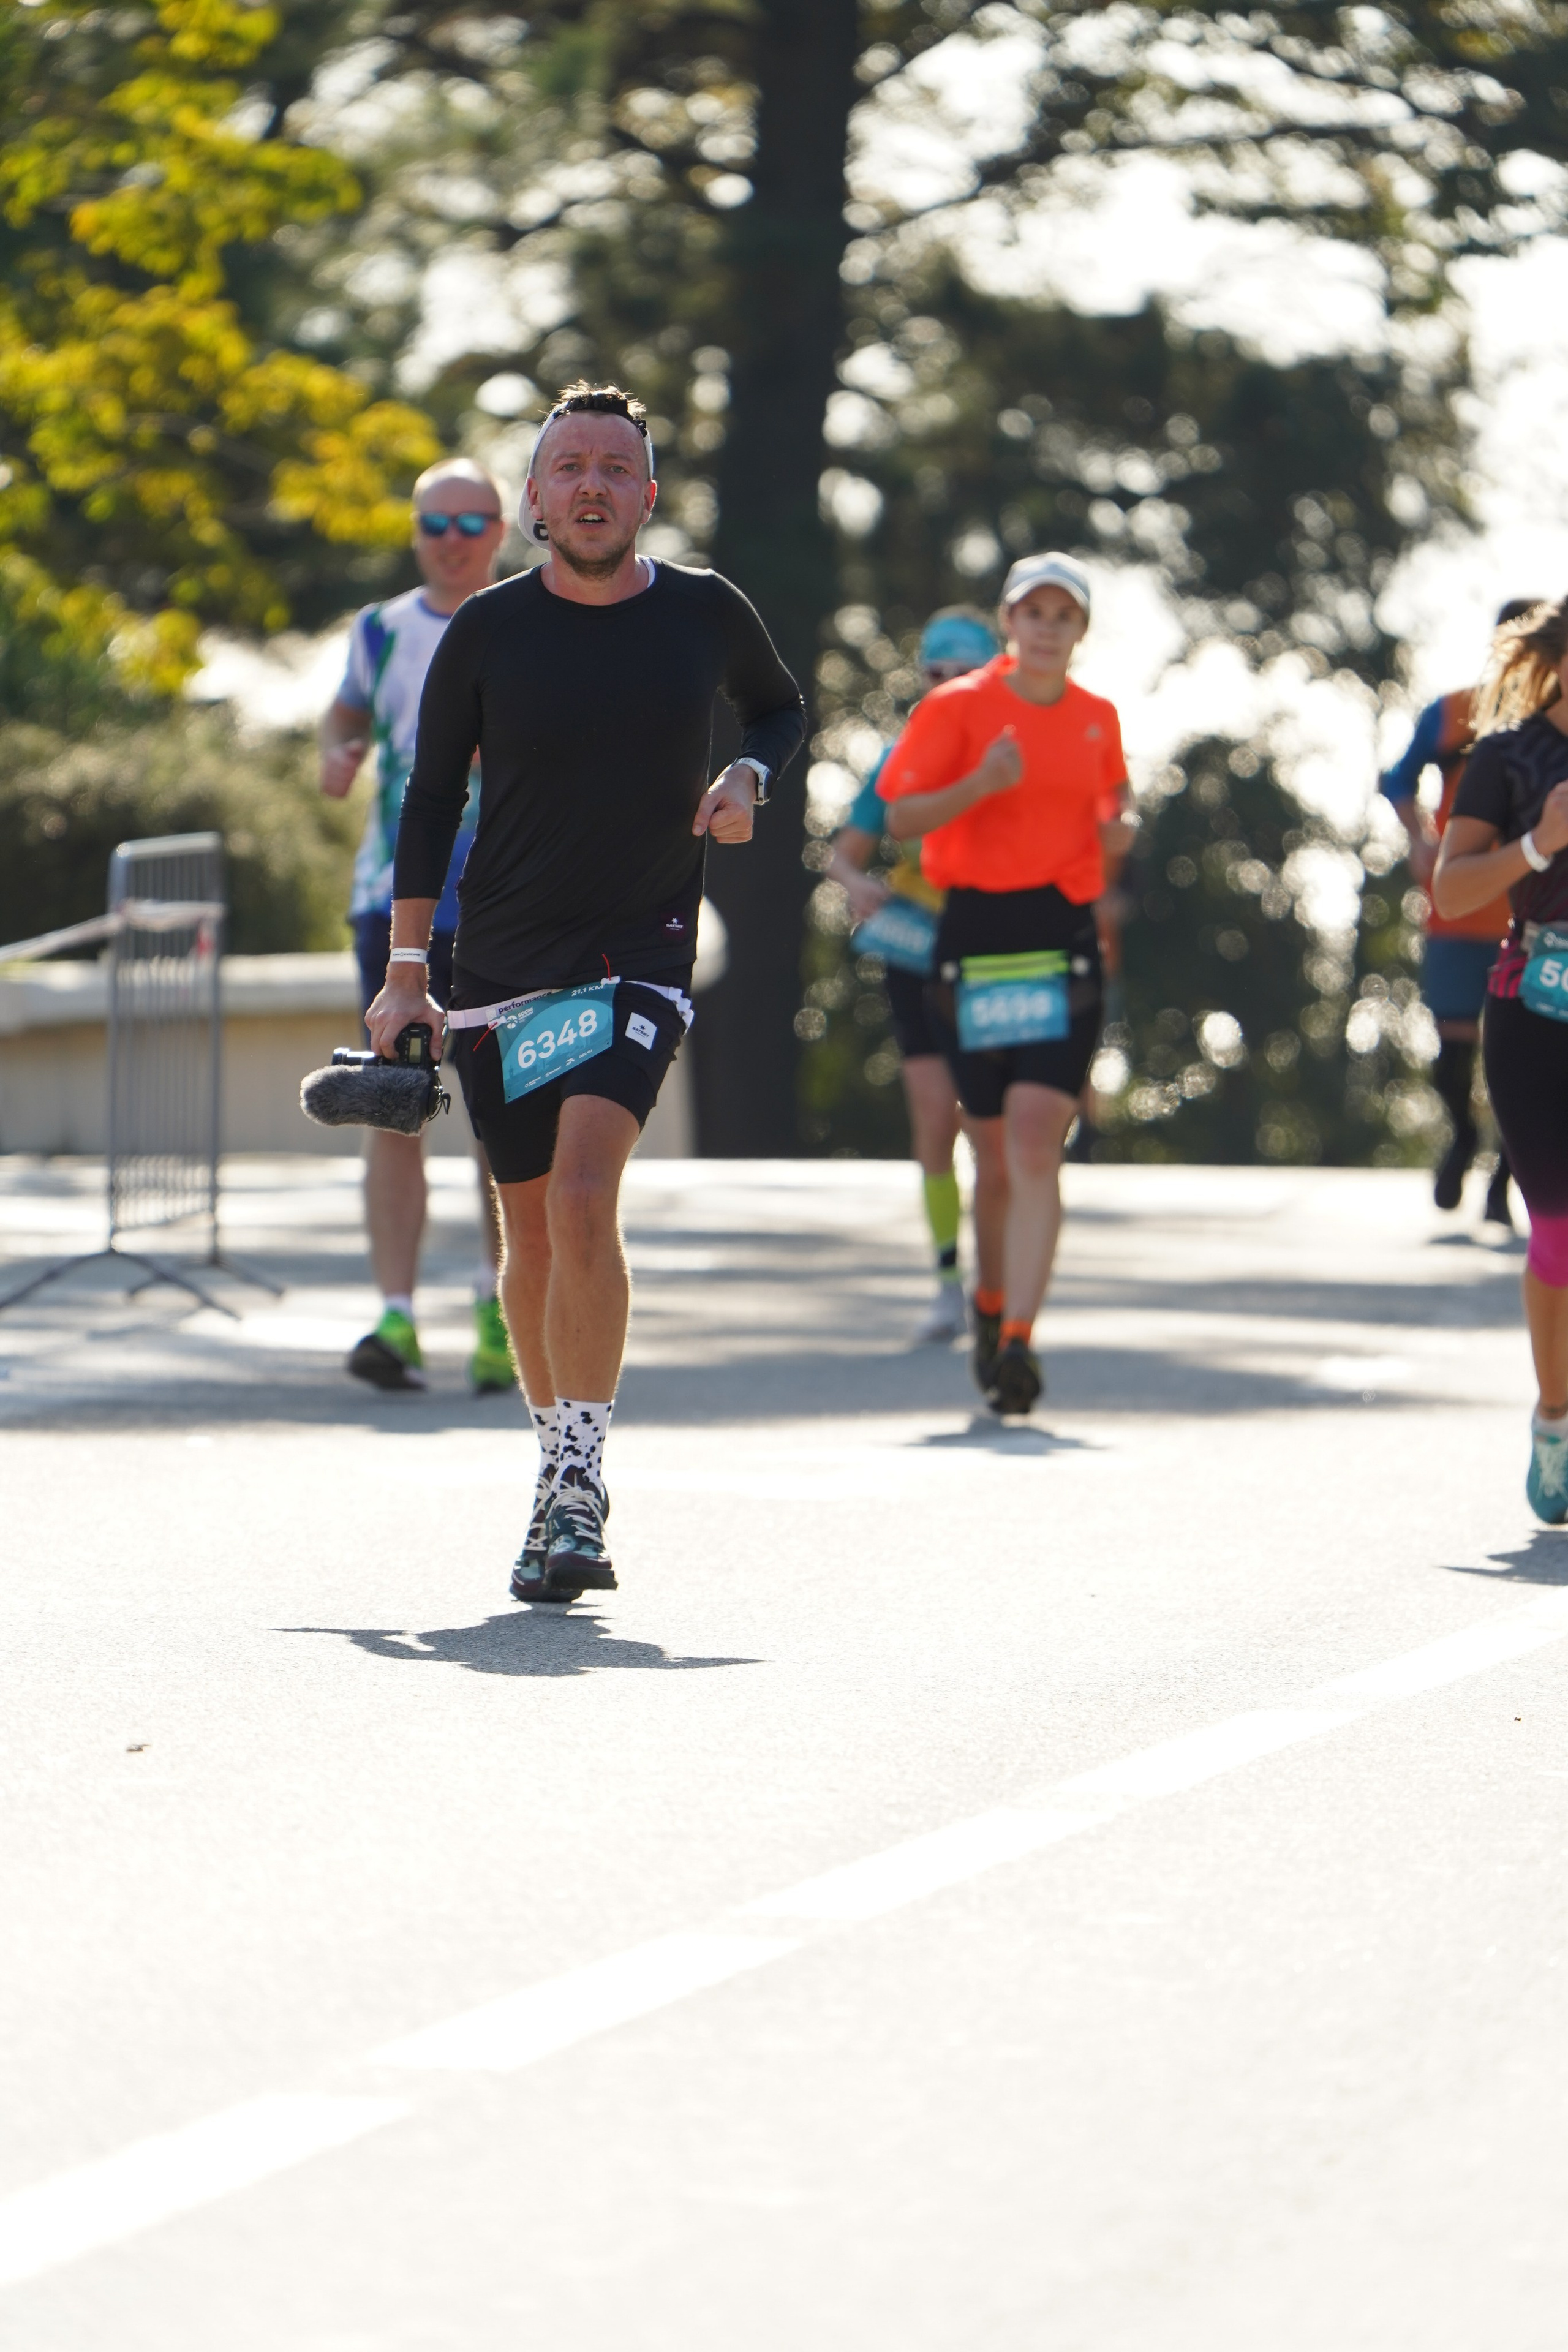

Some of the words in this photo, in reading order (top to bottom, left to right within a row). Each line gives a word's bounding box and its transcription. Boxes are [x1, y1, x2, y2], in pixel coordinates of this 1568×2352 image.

[571, 987, 587, 997] 21,1
[518, 1007, 533, 1017] SOCHI
[518, 1009, 597, 1068] 6348
